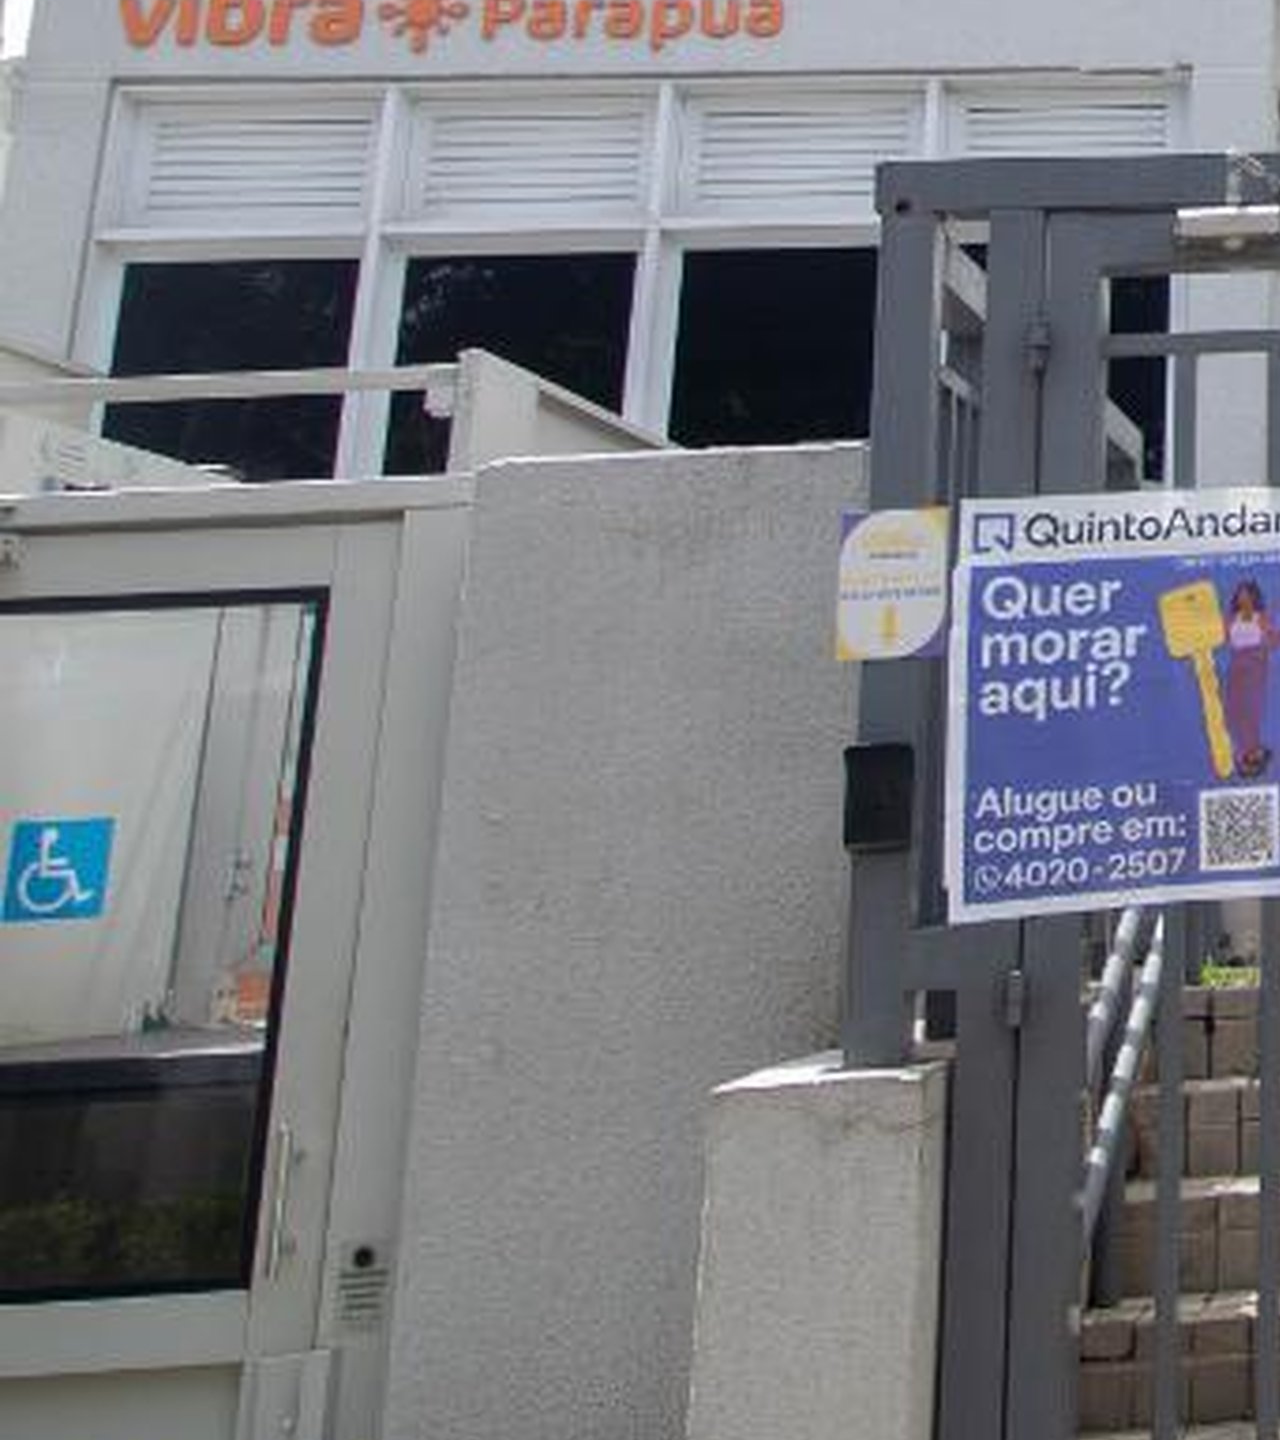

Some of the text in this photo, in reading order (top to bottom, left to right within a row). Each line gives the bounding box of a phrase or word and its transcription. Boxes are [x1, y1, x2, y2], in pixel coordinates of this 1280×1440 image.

[982, 576, 1122, 620] Quer
[981, 624, 1147, 668] morar
[979, 661, 1131, 721] aqui?
[975, 783, 1157, 822] Alugue ou
[974, 814, 1187, 854] compre em:
